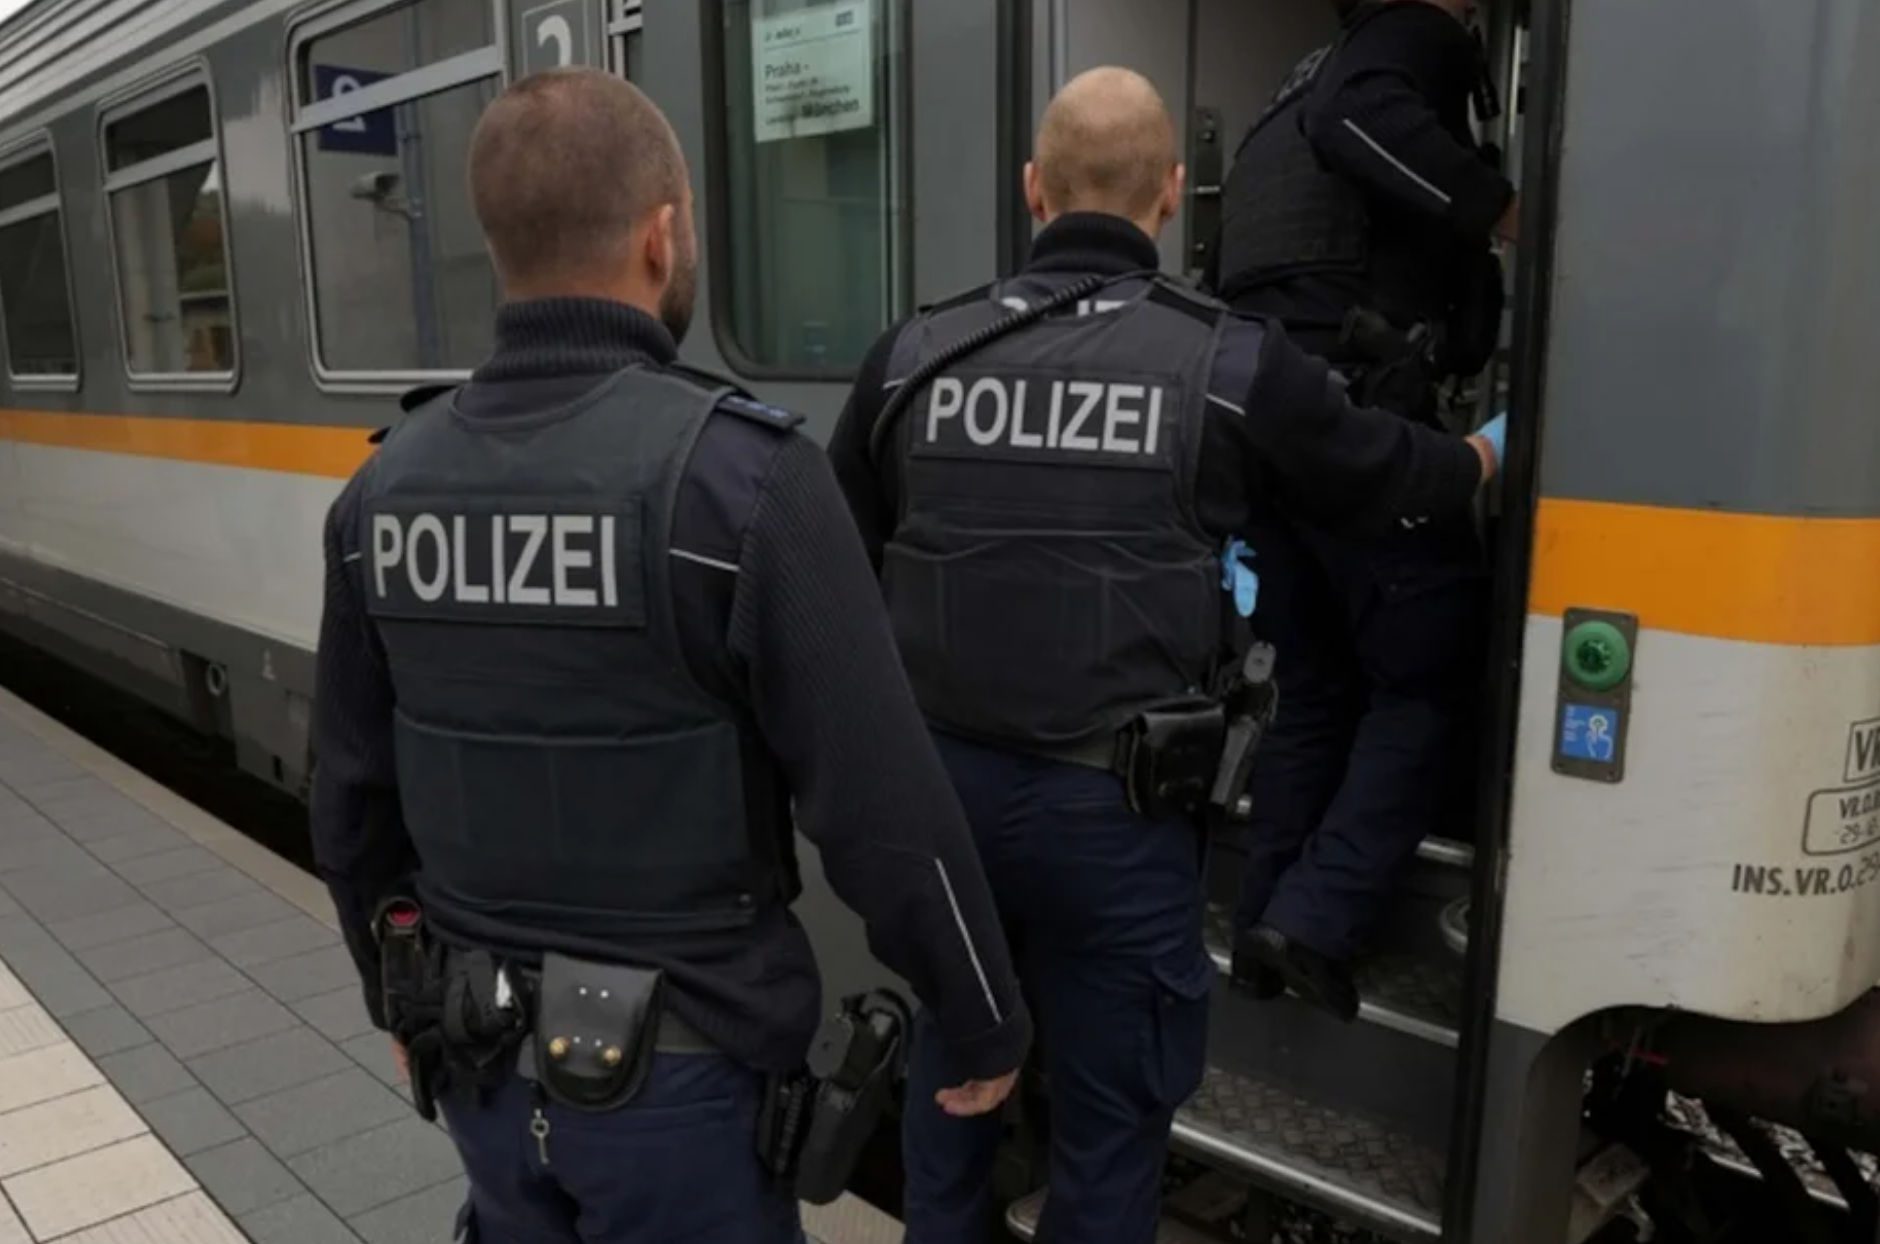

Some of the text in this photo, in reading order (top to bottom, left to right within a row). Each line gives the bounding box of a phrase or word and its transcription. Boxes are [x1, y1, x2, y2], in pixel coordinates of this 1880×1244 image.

[764, 62, 801, 79] Praha
[925, 376, 1163, 455] POLIZEI
[372, 513, 619, 607] POLIZEI
